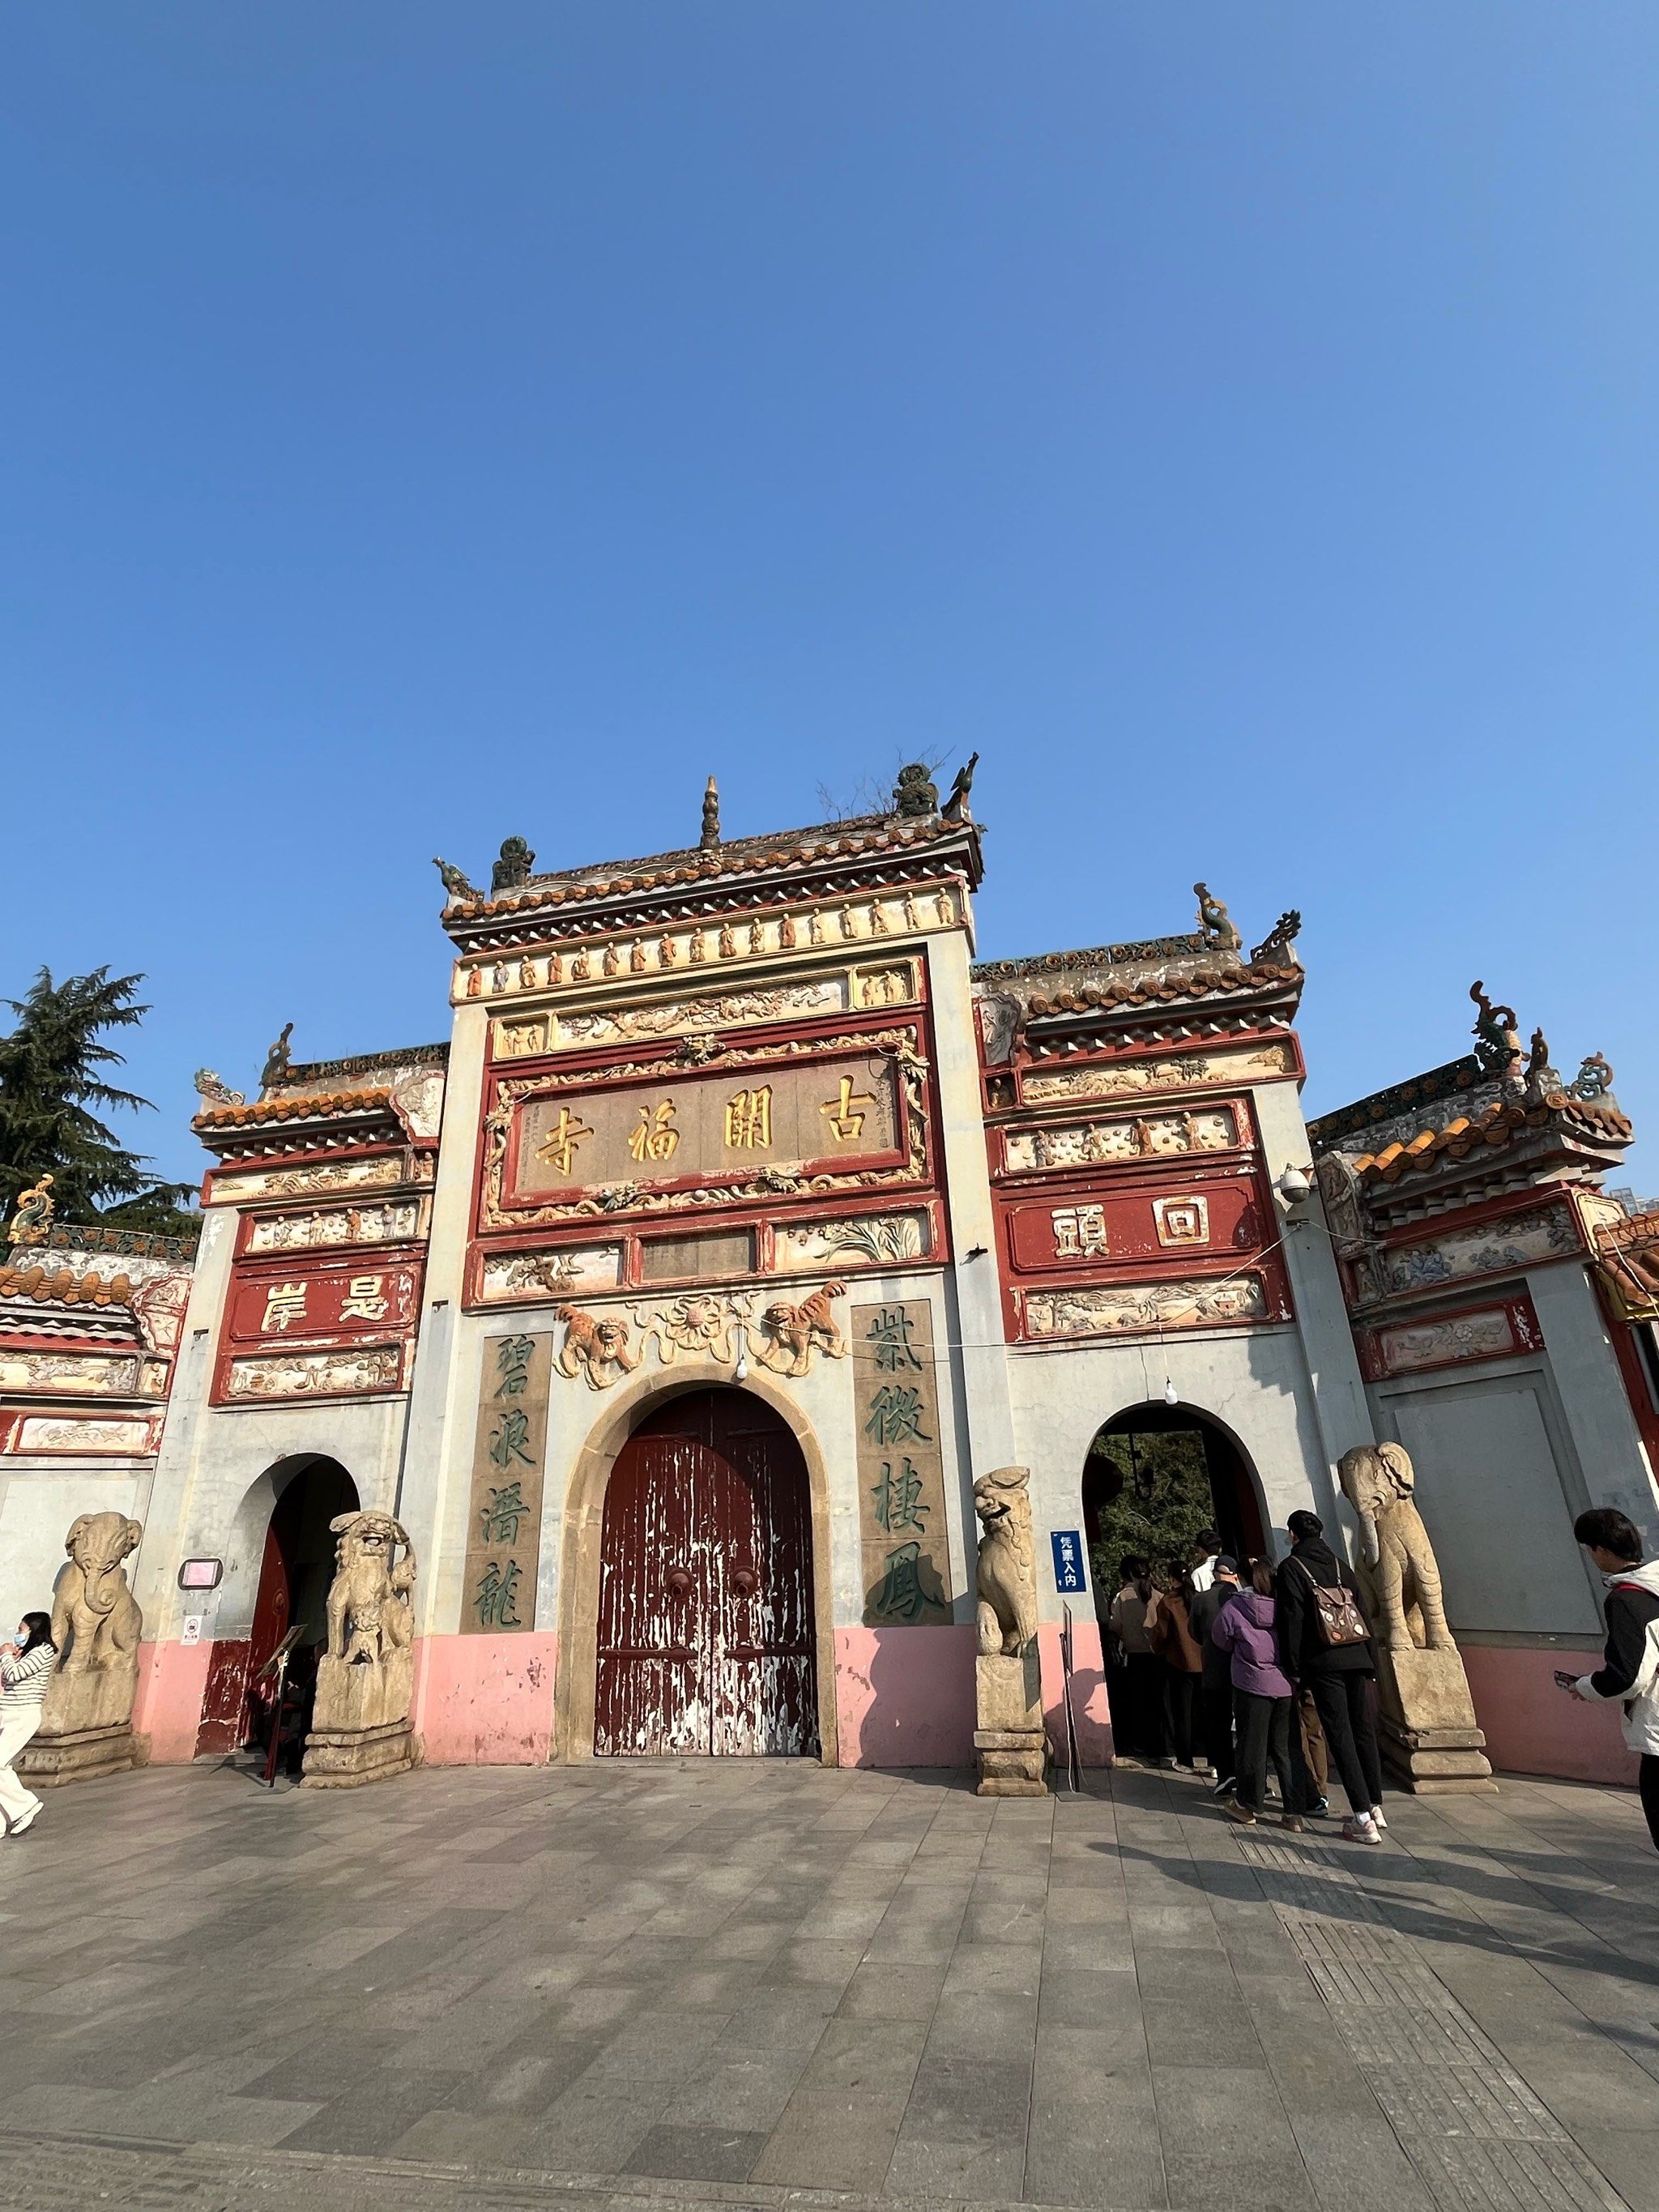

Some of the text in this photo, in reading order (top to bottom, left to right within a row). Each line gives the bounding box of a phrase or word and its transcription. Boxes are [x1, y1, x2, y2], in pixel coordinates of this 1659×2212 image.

[535, 1074, 880, 1176] 古開福寺
[1051, 1195, 1211, 1258] 回頭
[260, 1275, 390, 1332] 是岸
